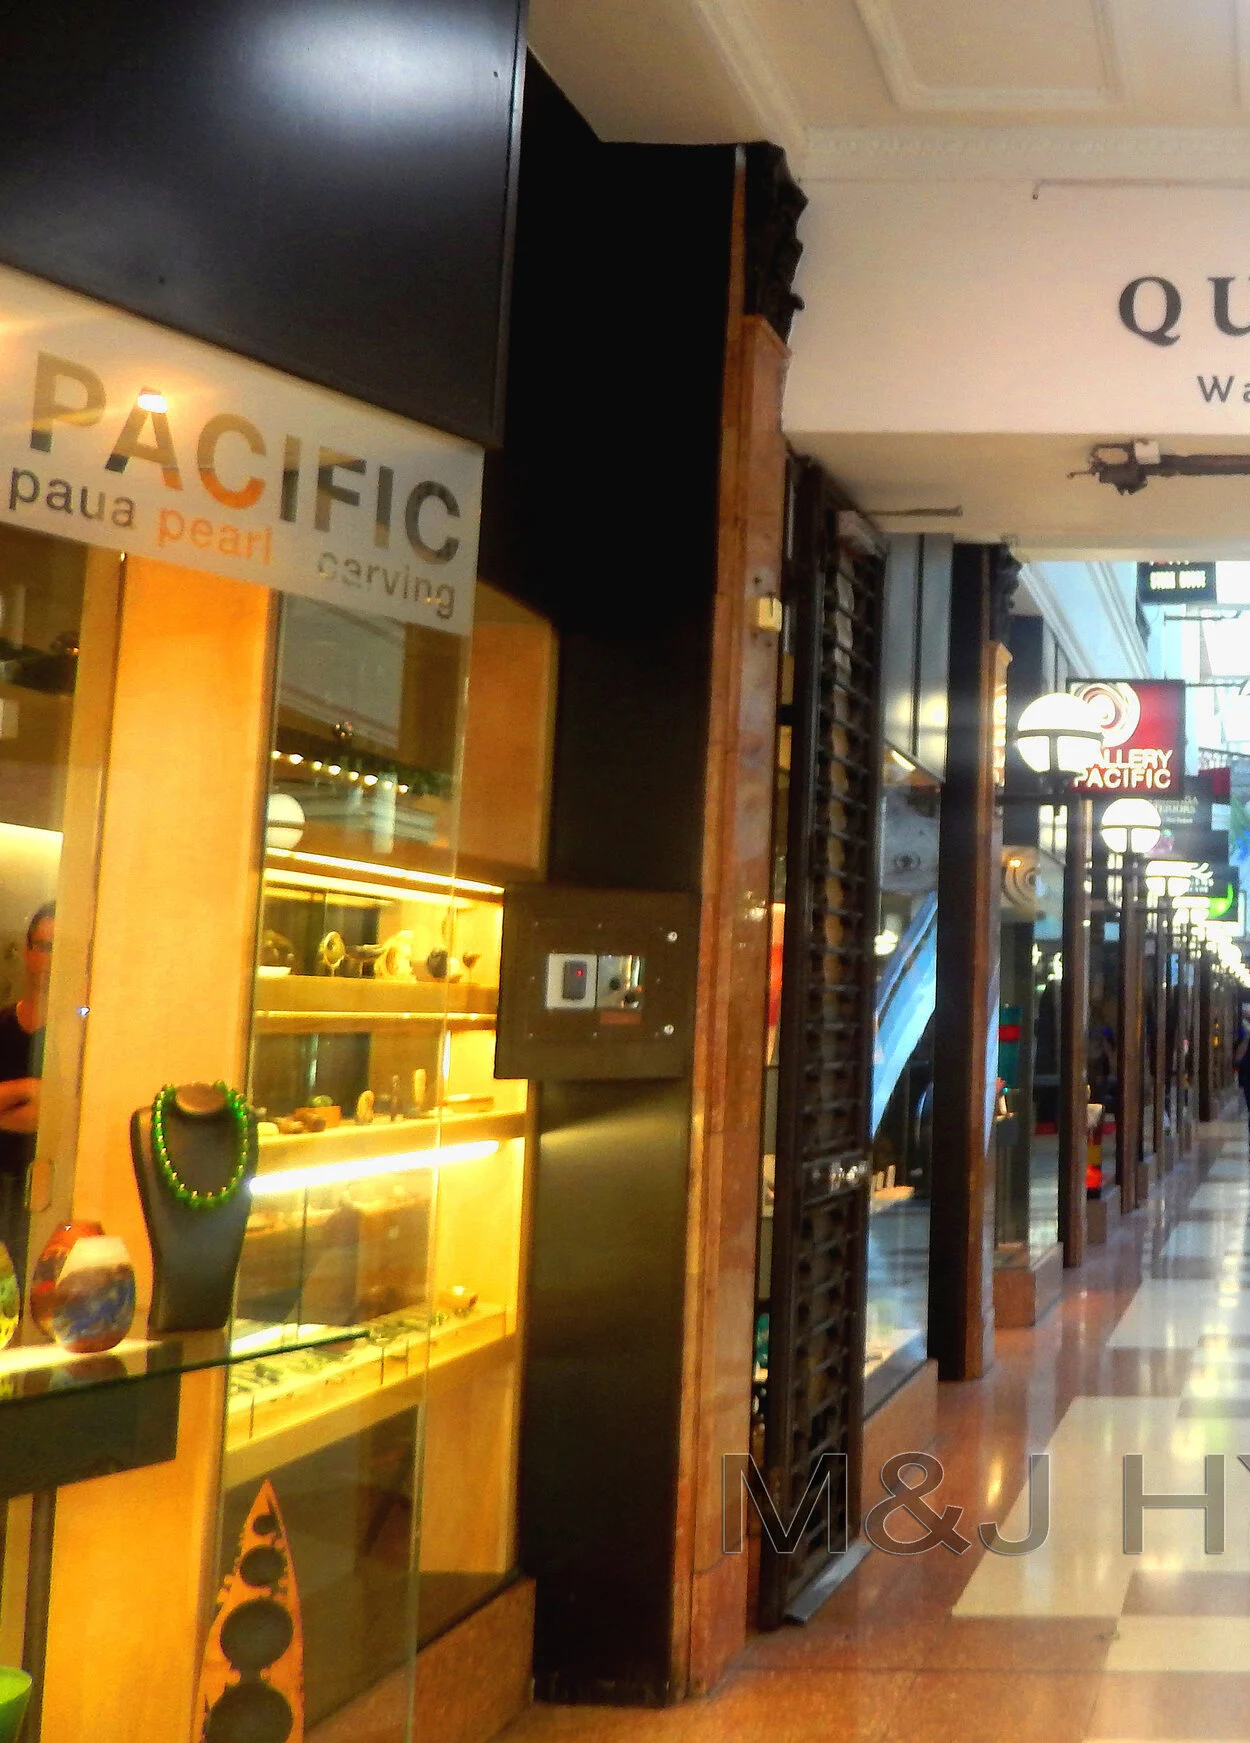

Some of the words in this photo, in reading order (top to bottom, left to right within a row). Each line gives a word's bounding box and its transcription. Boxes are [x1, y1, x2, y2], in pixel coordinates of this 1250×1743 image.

[29, 351, 461, 565] PACIFIC
[9, 467, 136, 529] paua
[157, 507, 273, 564] pearl
[317, 551, 456, 621] carving
[1074, 767, 1172, 789] PACIFIC
[1091, 749, 1173, 770] ALLERY
